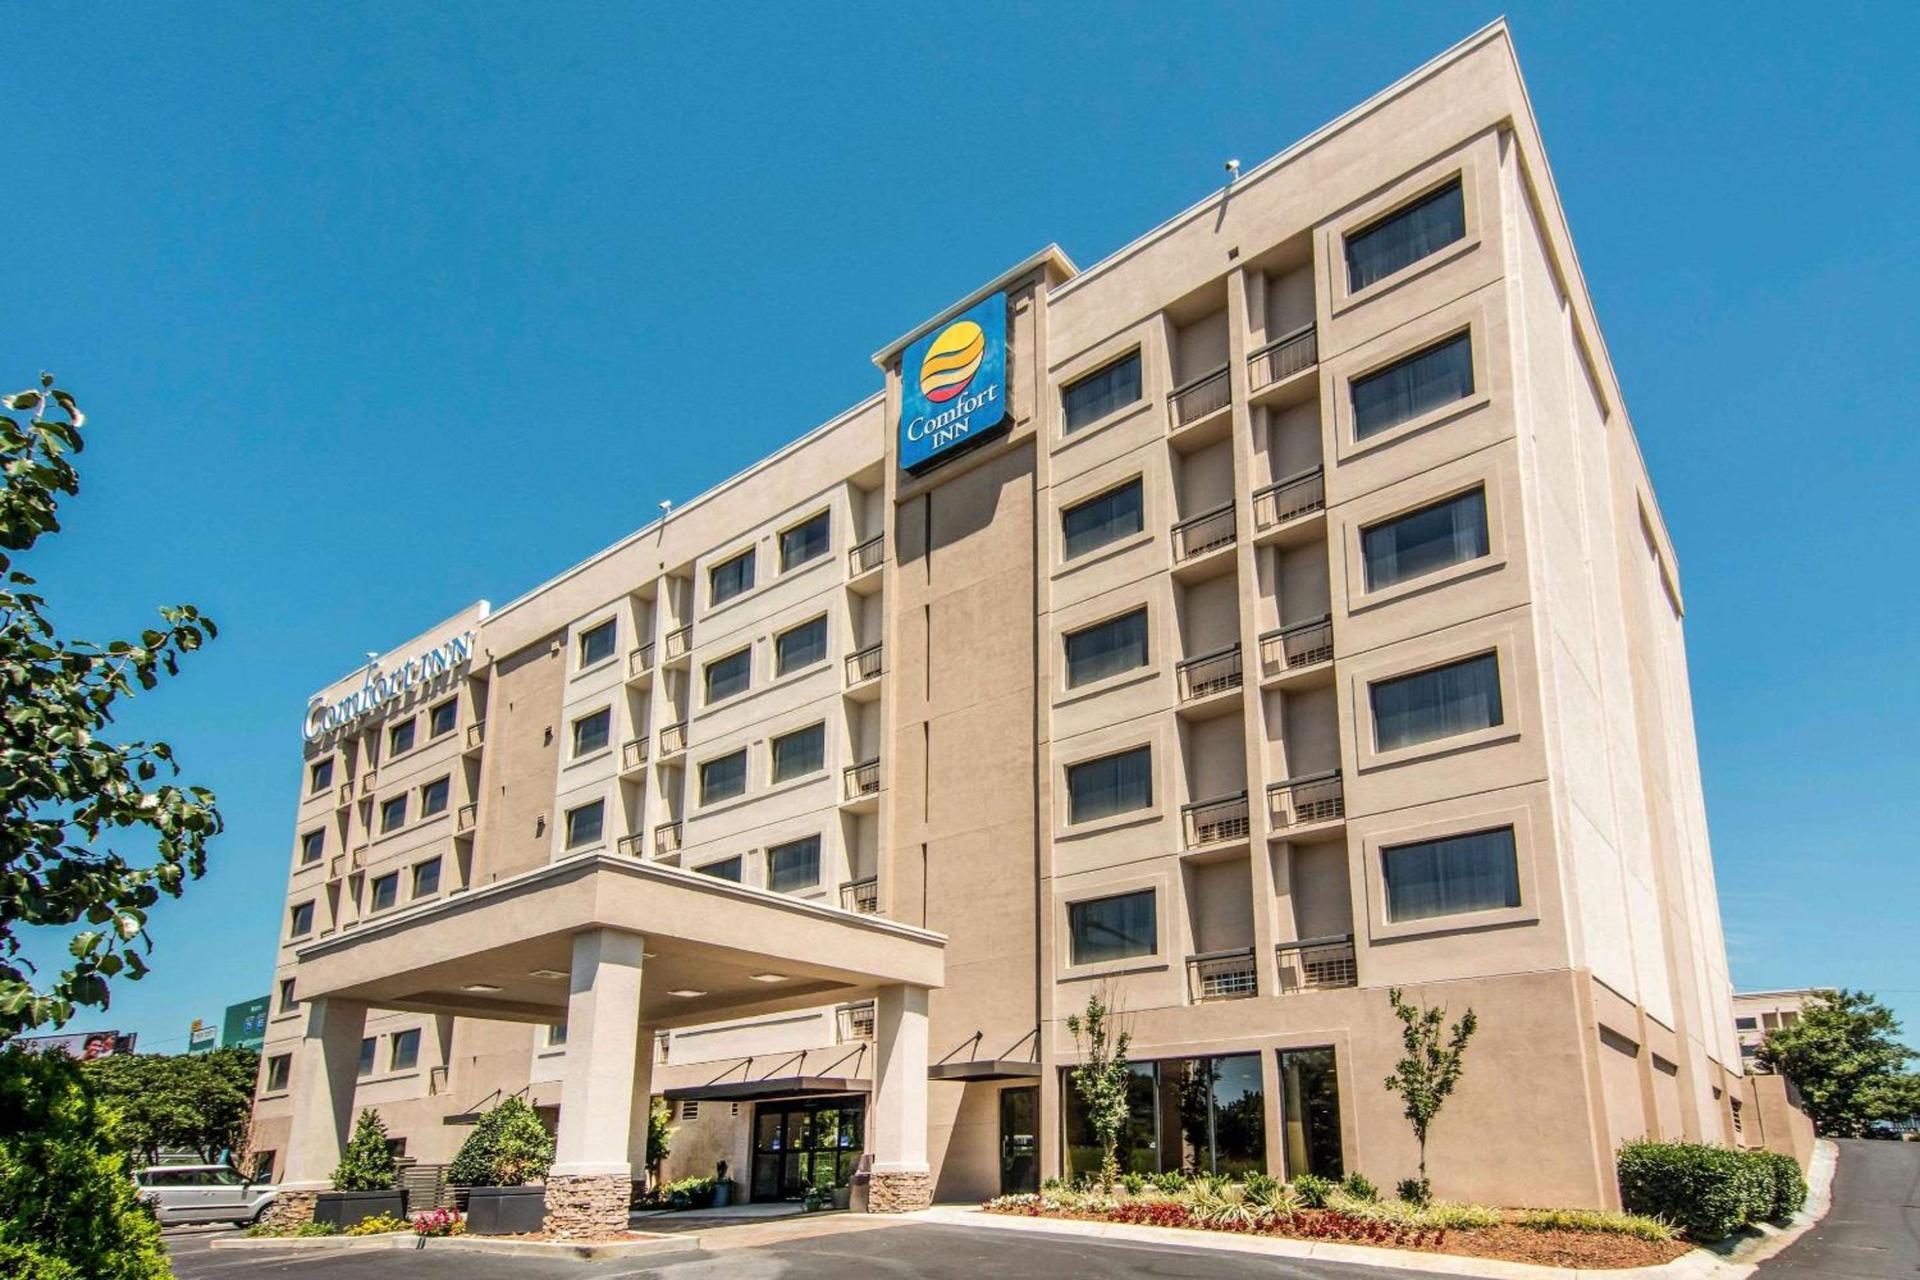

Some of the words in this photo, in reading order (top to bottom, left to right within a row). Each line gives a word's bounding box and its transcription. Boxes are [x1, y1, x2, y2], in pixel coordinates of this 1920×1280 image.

[907, 384, 998, 442] Comfort
[932, 416, 970, 450] INN
[302, 656, 418, 742] Comfort
[419, 630, 477, 682] INN
